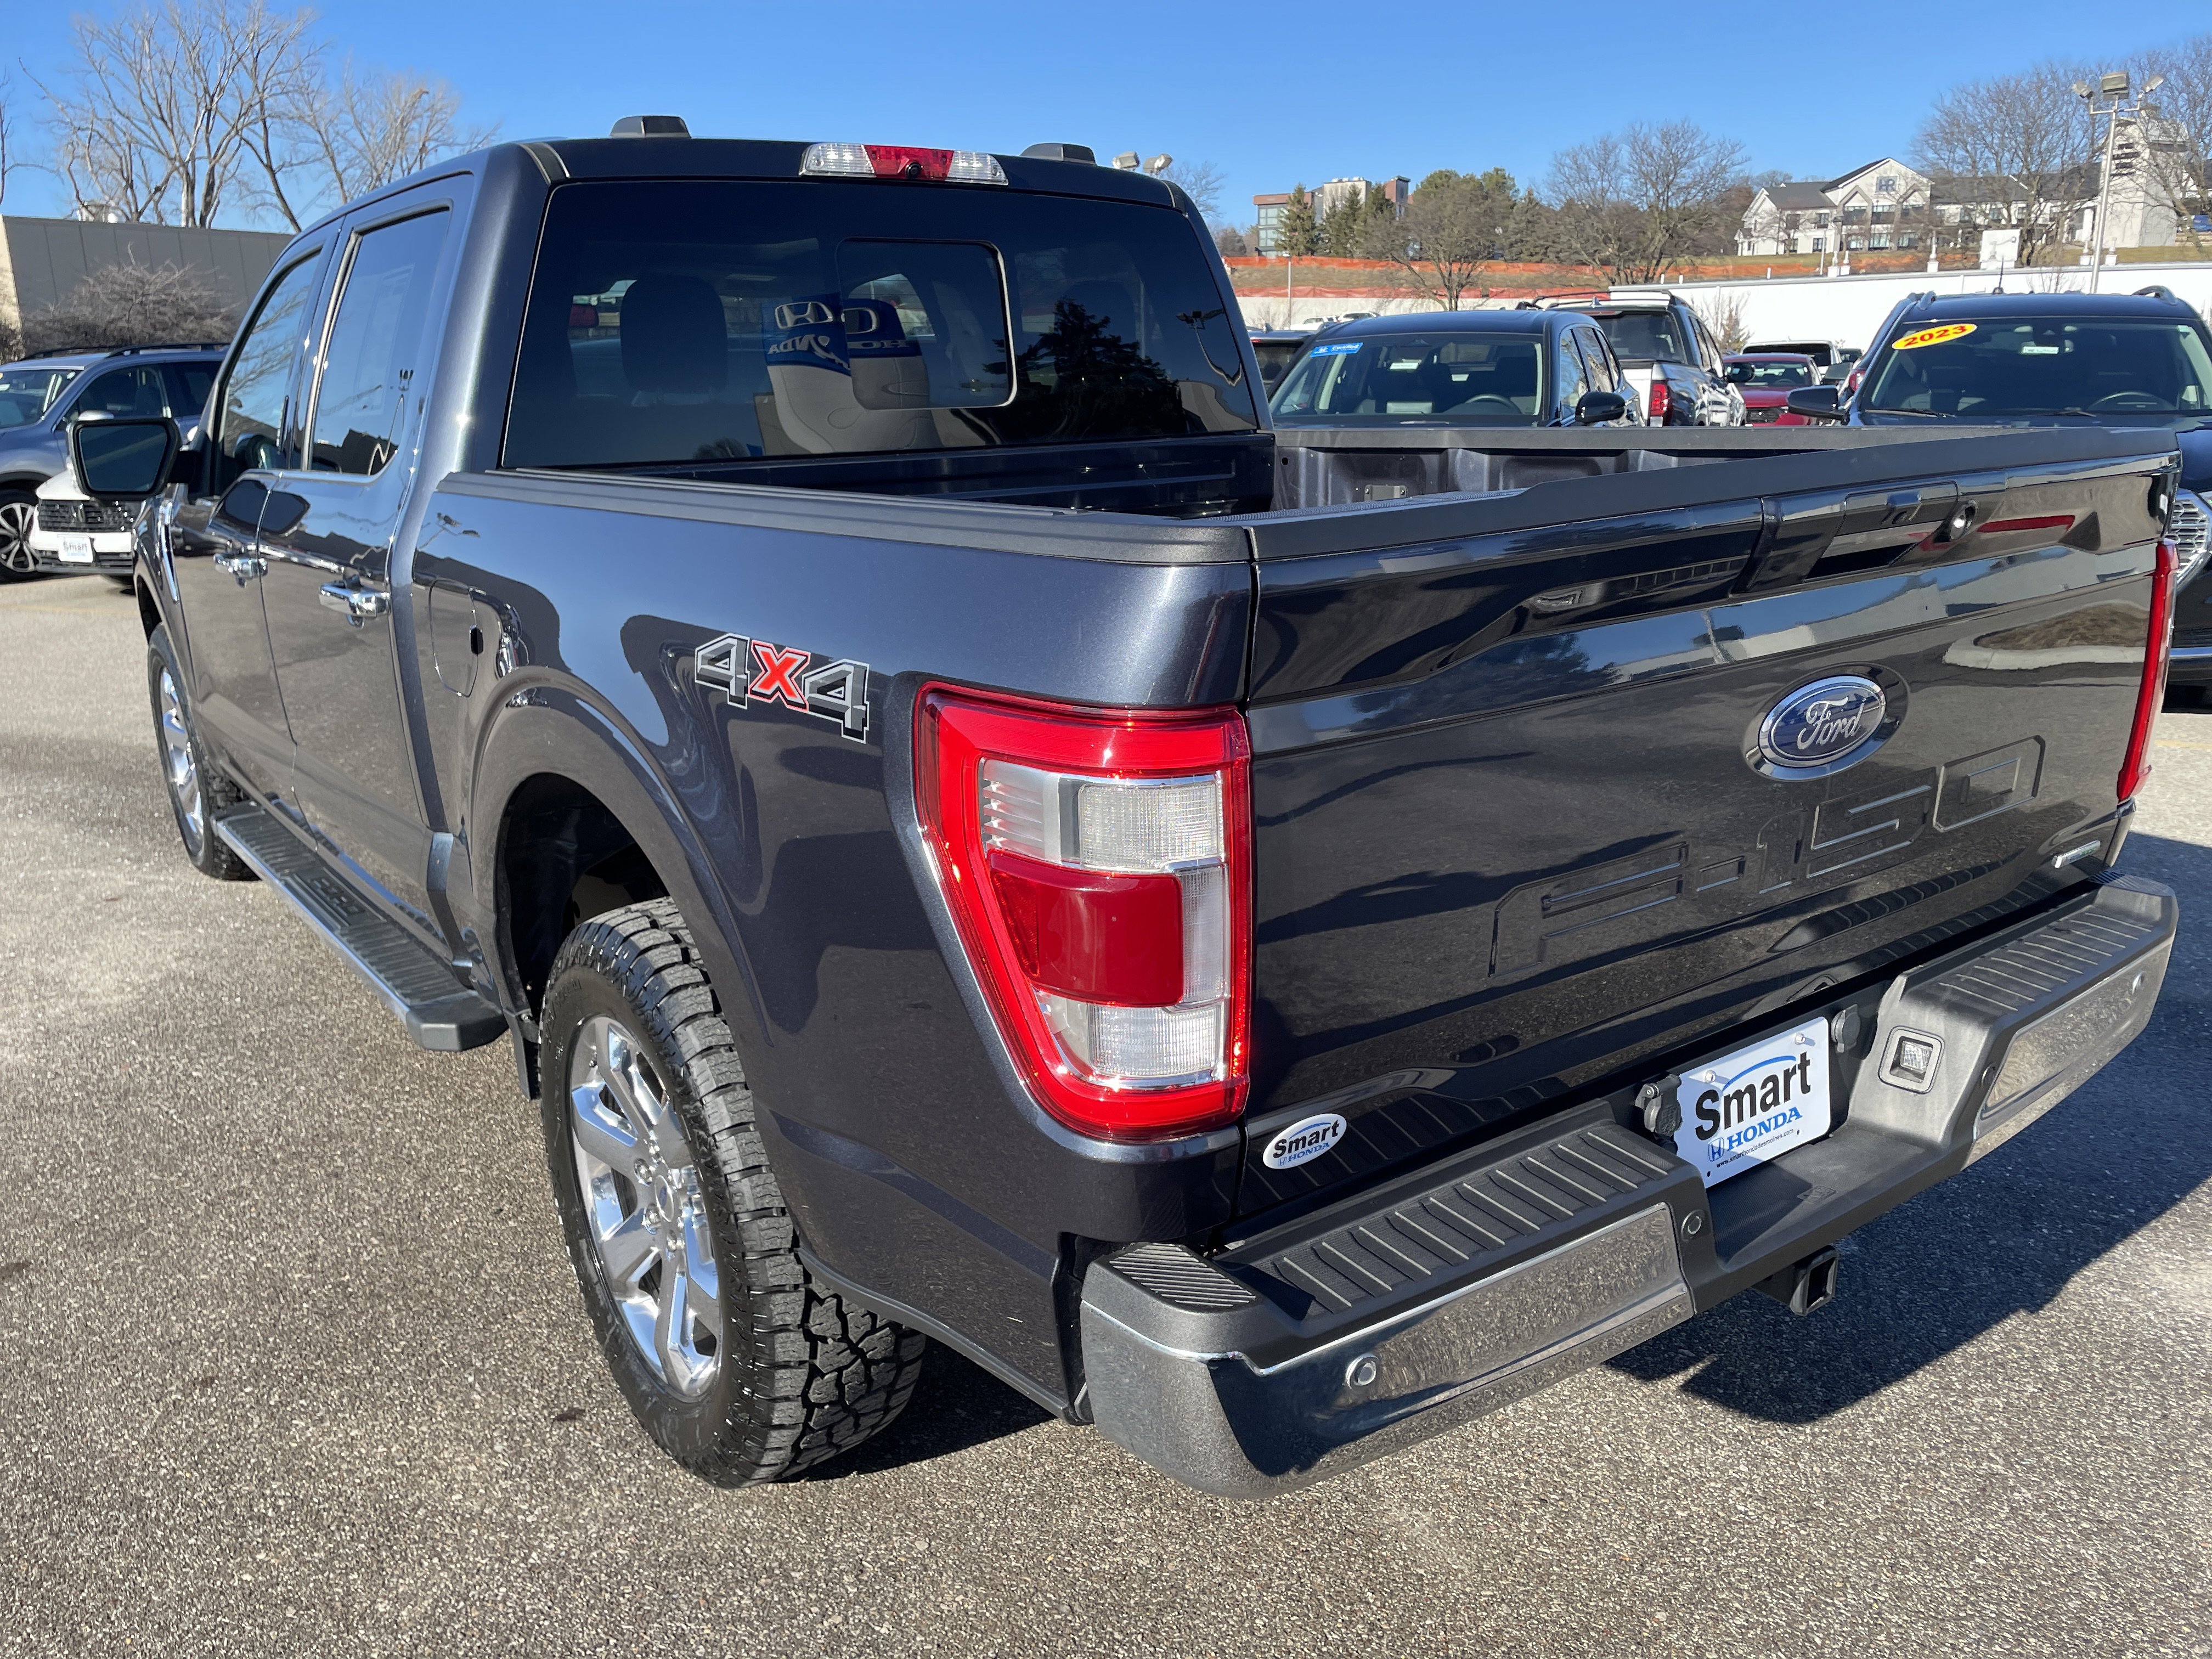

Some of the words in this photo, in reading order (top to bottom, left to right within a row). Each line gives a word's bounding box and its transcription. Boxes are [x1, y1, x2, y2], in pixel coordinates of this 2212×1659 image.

[1904, 326, 1967, 347] 2023
[1797, 696, 1866, 749] Ford
[1695, 1052, 1811, 1141] Smart
[1273, 1119, 1339, 1158] Smart
[1716, 1128, 1794, 1168] www.smarthondadesmoines.com
[1727, 1107, 1803, 1152] HONDA
[1288, 1142, 1330, 1163] HONDA
